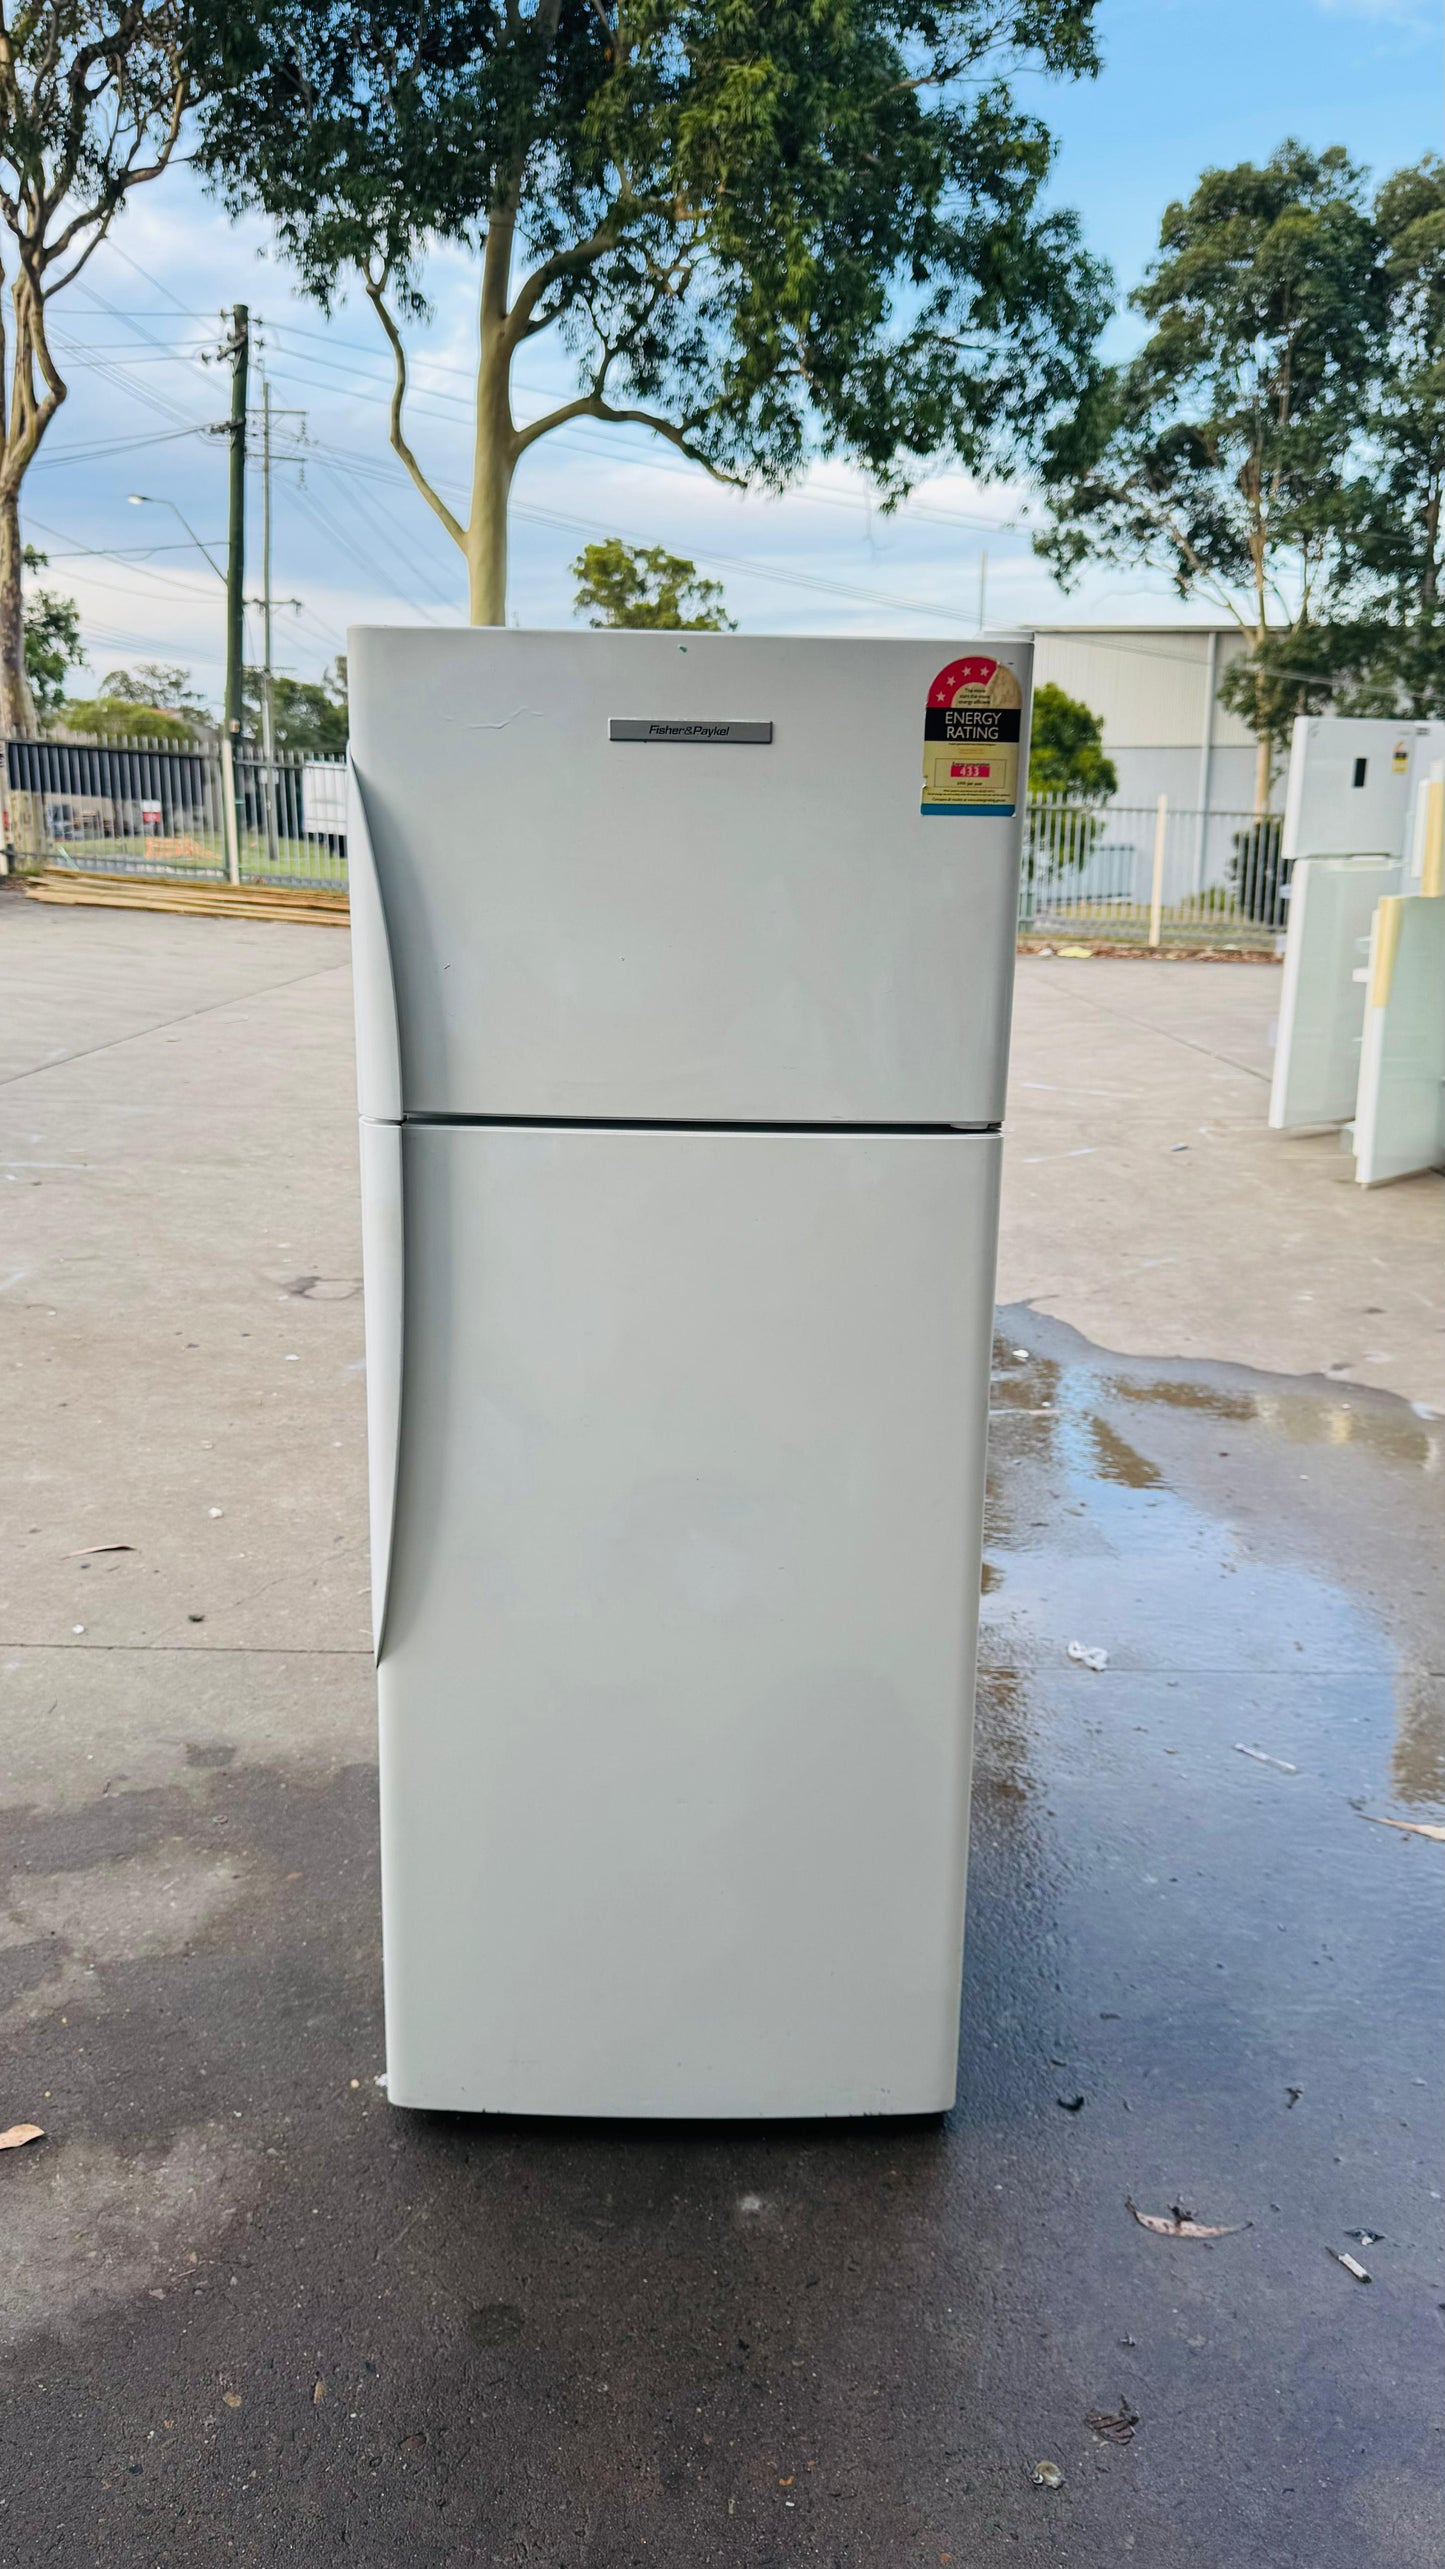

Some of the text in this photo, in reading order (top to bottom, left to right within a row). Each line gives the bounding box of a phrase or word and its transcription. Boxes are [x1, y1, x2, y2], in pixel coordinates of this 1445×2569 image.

[945, 711, 1002, 725] ENERGY
[649, 725, 730, 737] Fisher&Paykel
[946, 726, 999, 740] RATING
[959, 766, 980, 777] 433
